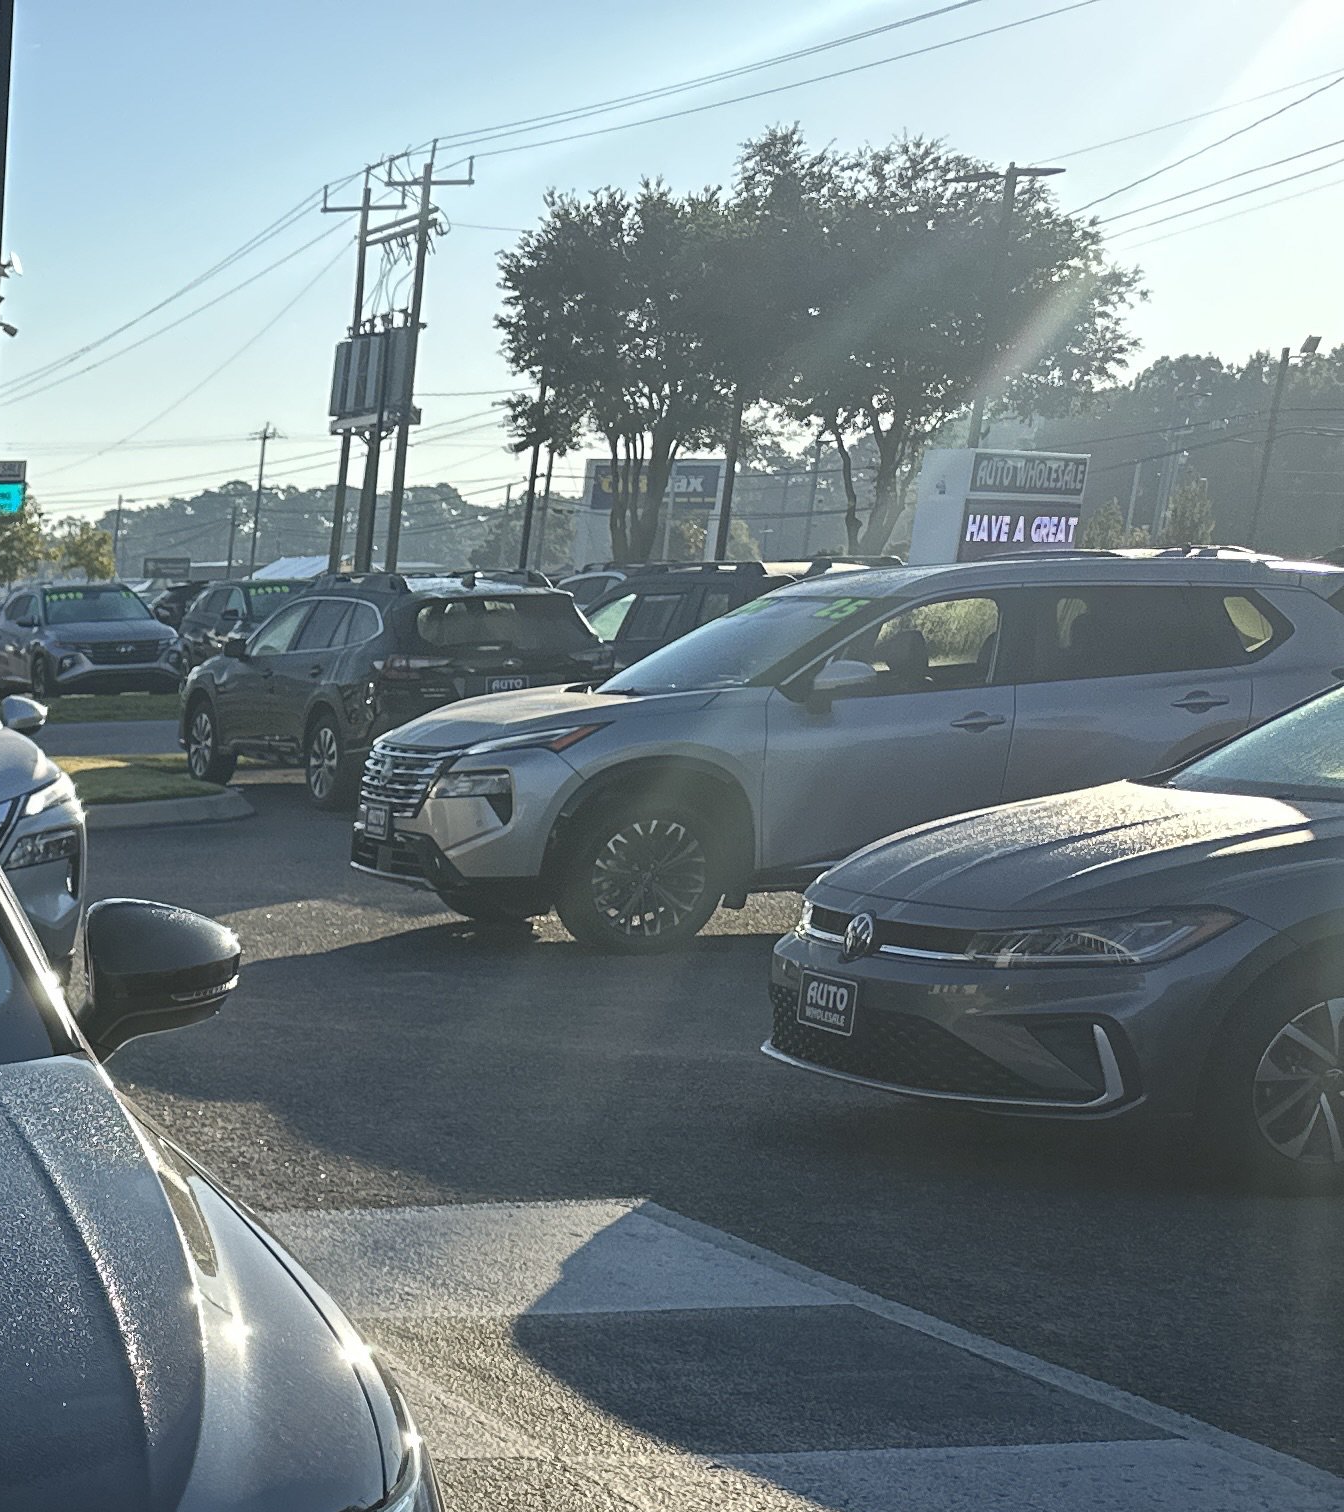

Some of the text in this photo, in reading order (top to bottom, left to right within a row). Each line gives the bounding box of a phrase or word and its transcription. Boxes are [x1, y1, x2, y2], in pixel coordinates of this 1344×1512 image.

[976, 459, 1085, 490] AUTO WHOLESALE
[965, 514, 1079, 543] HAVE A GREAT
[806, 981, 849, 1011] AUTO
